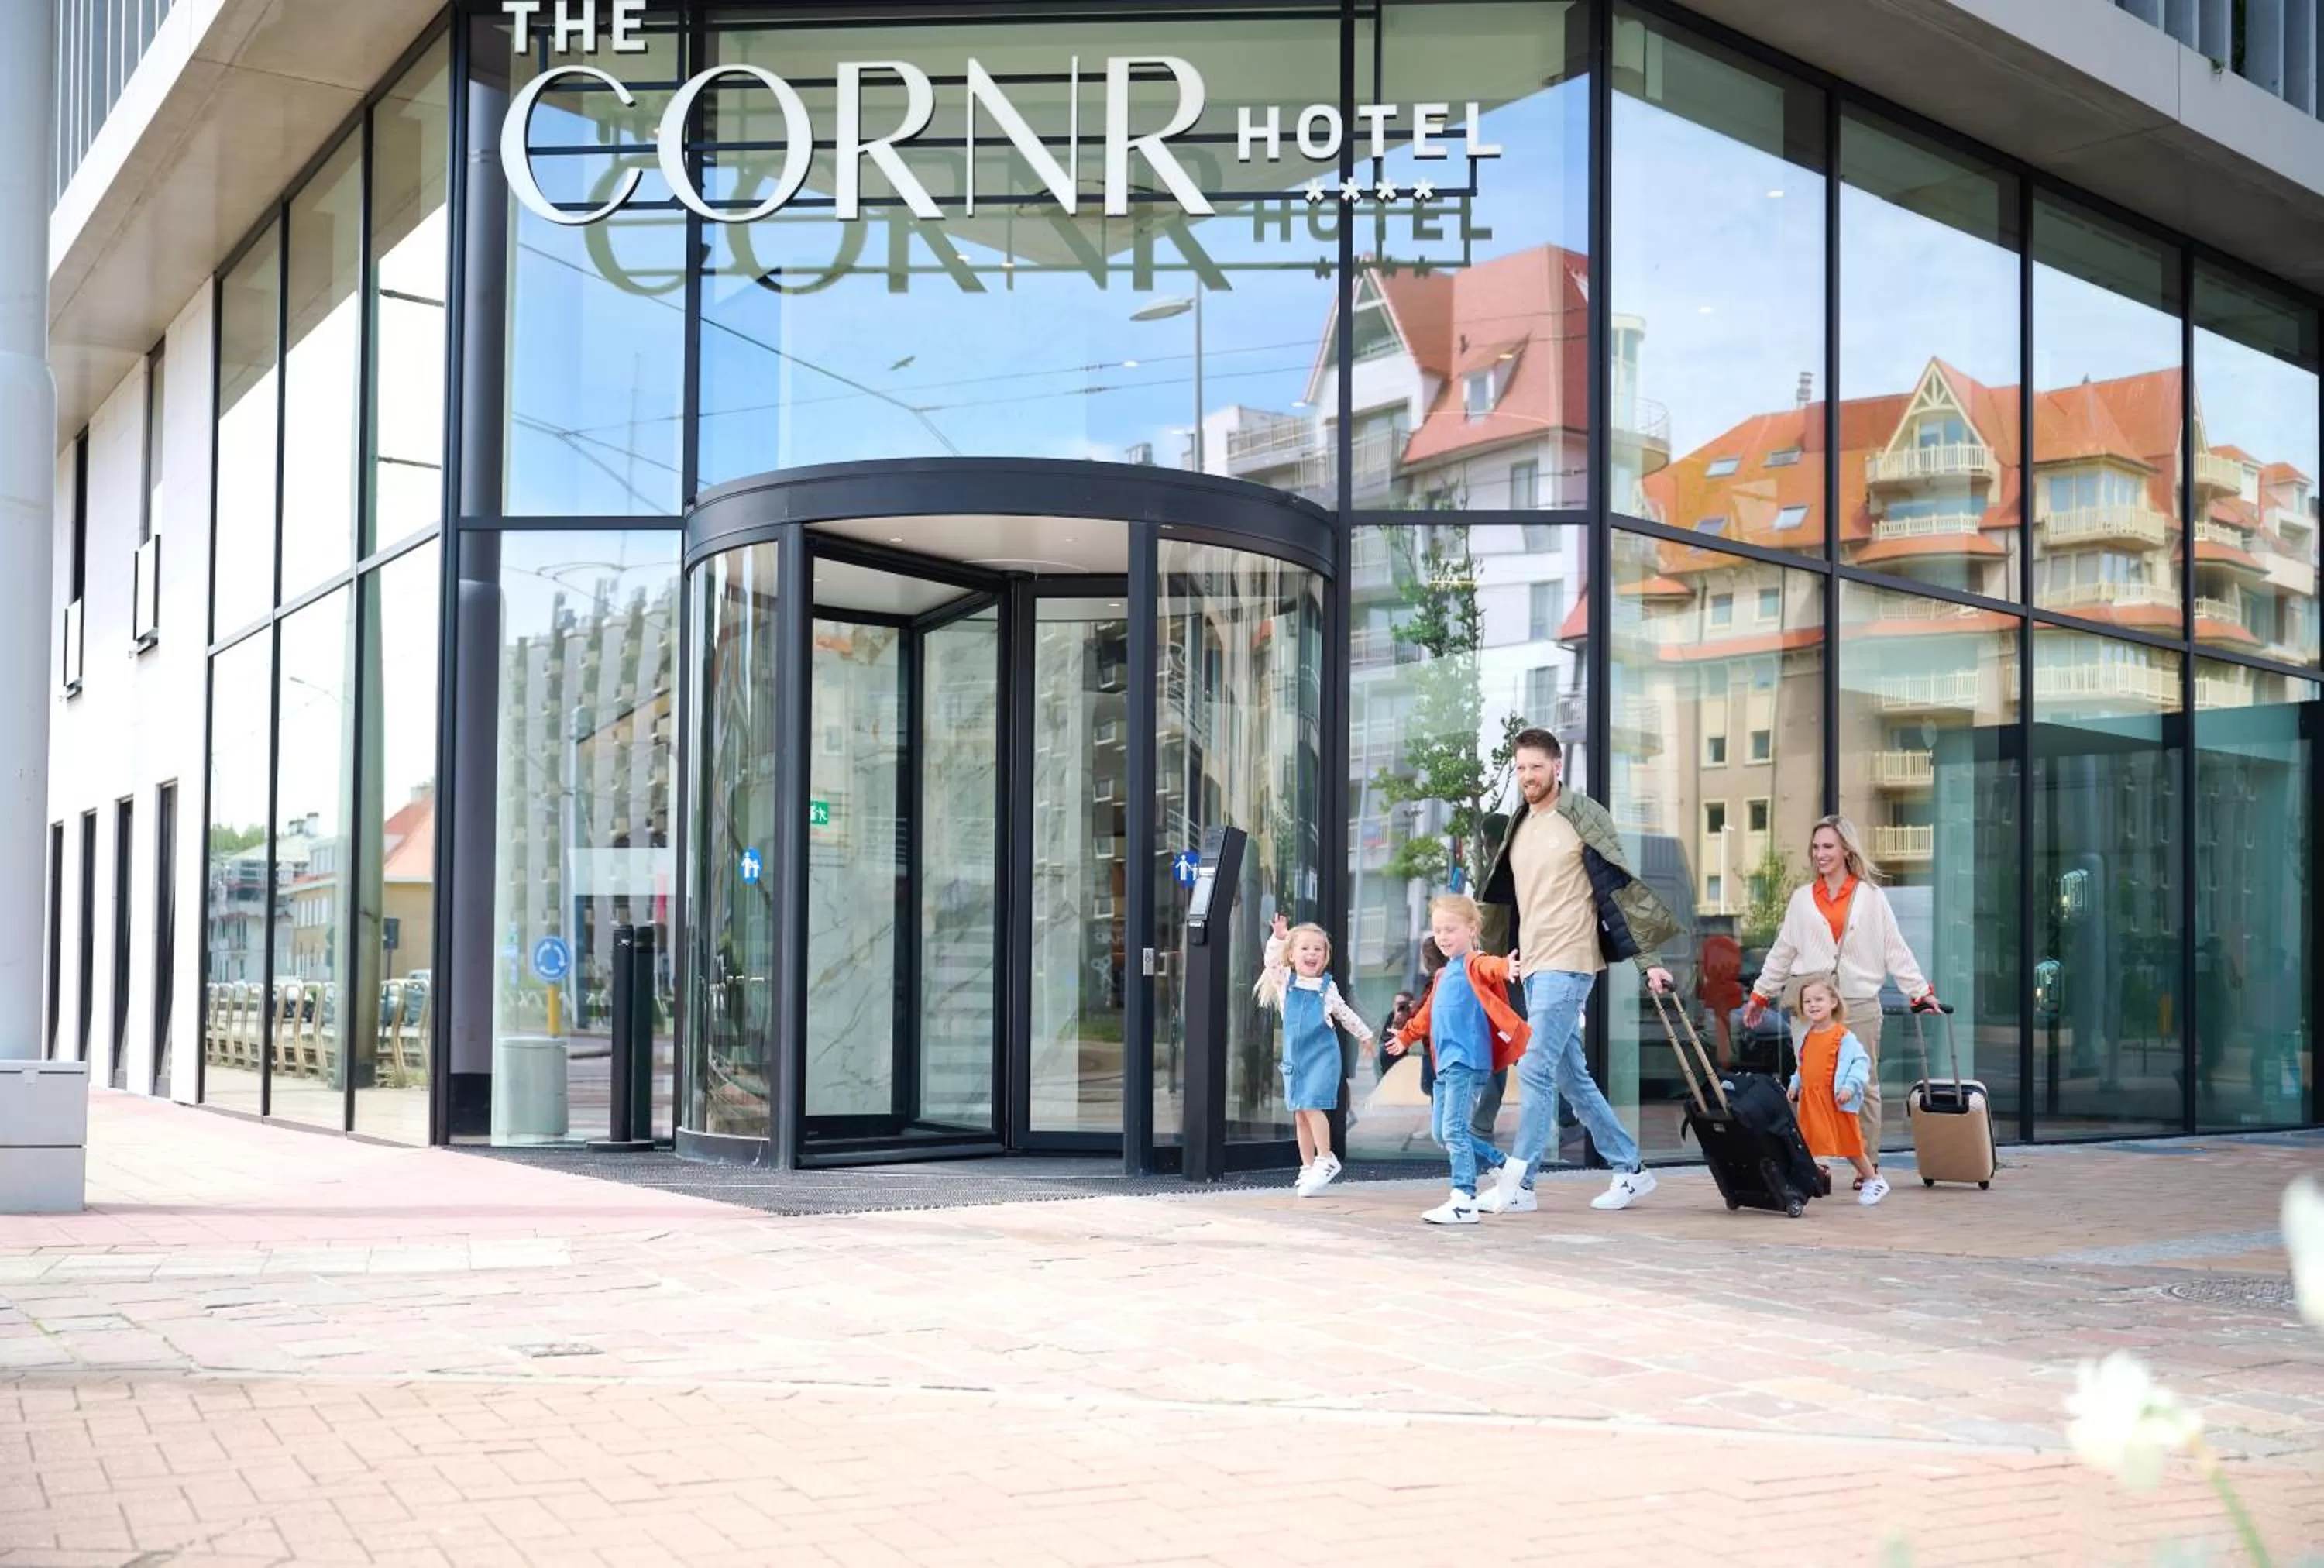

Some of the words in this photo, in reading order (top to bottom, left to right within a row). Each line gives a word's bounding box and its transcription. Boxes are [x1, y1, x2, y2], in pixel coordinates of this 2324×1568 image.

[502, 0, 648, 53] THE
[500, 55, 1216, 225] CORNR
[1237, 101, 1503, 163] HOTEL
